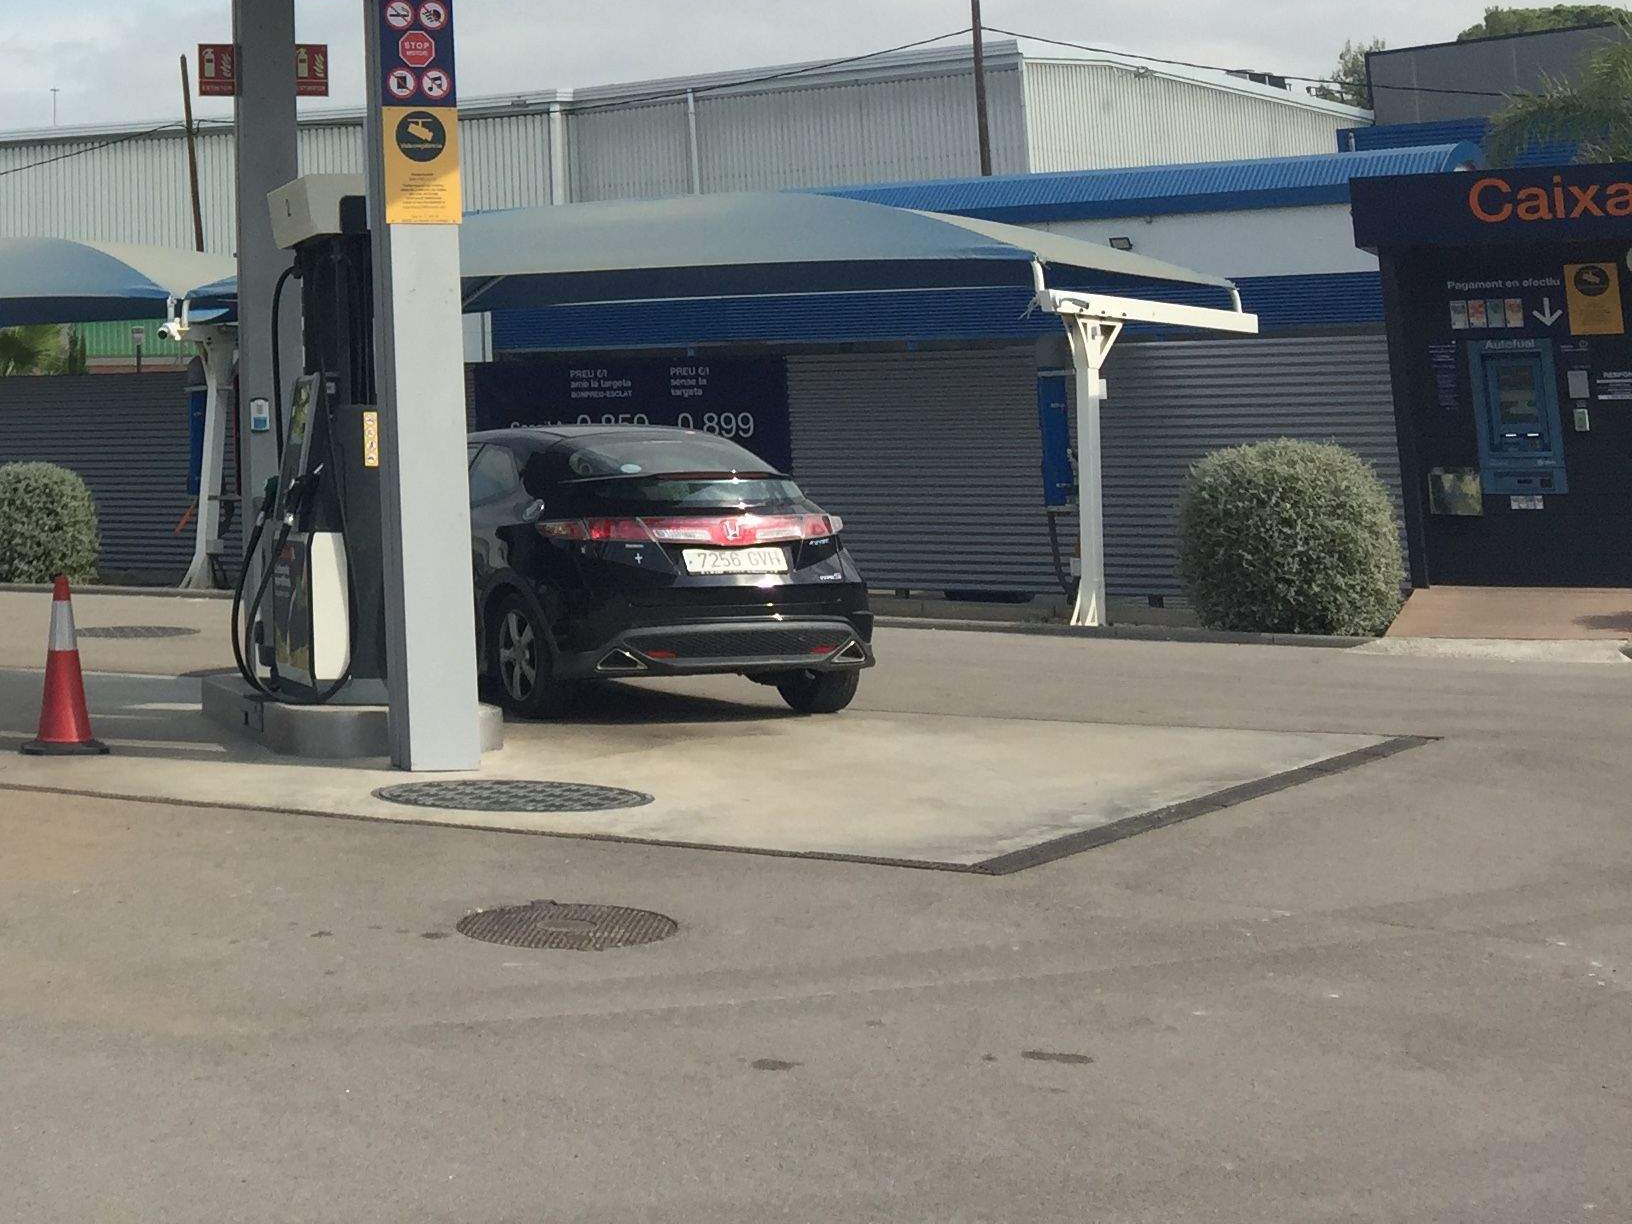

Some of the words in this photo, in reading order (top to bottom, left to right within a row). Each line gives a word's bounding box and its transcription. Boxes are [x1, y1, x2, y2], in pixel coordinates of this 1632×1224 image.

[404, 41, 430, 50] STOP
[1468, 175, 1632, 222] Caixa
[1447, 279, 1504, 291] Pagament
[1505, 280, 1519, 288] en
[1522, 277, 1561, 287] efectiu
[570, 369, 595, 378] PREU
[670, 367, 696, 376] PREU
[678, 412, 755, 437] 0899
[698, 551, 741, 568] 7256
[748, 550, 781, 567] GVH
